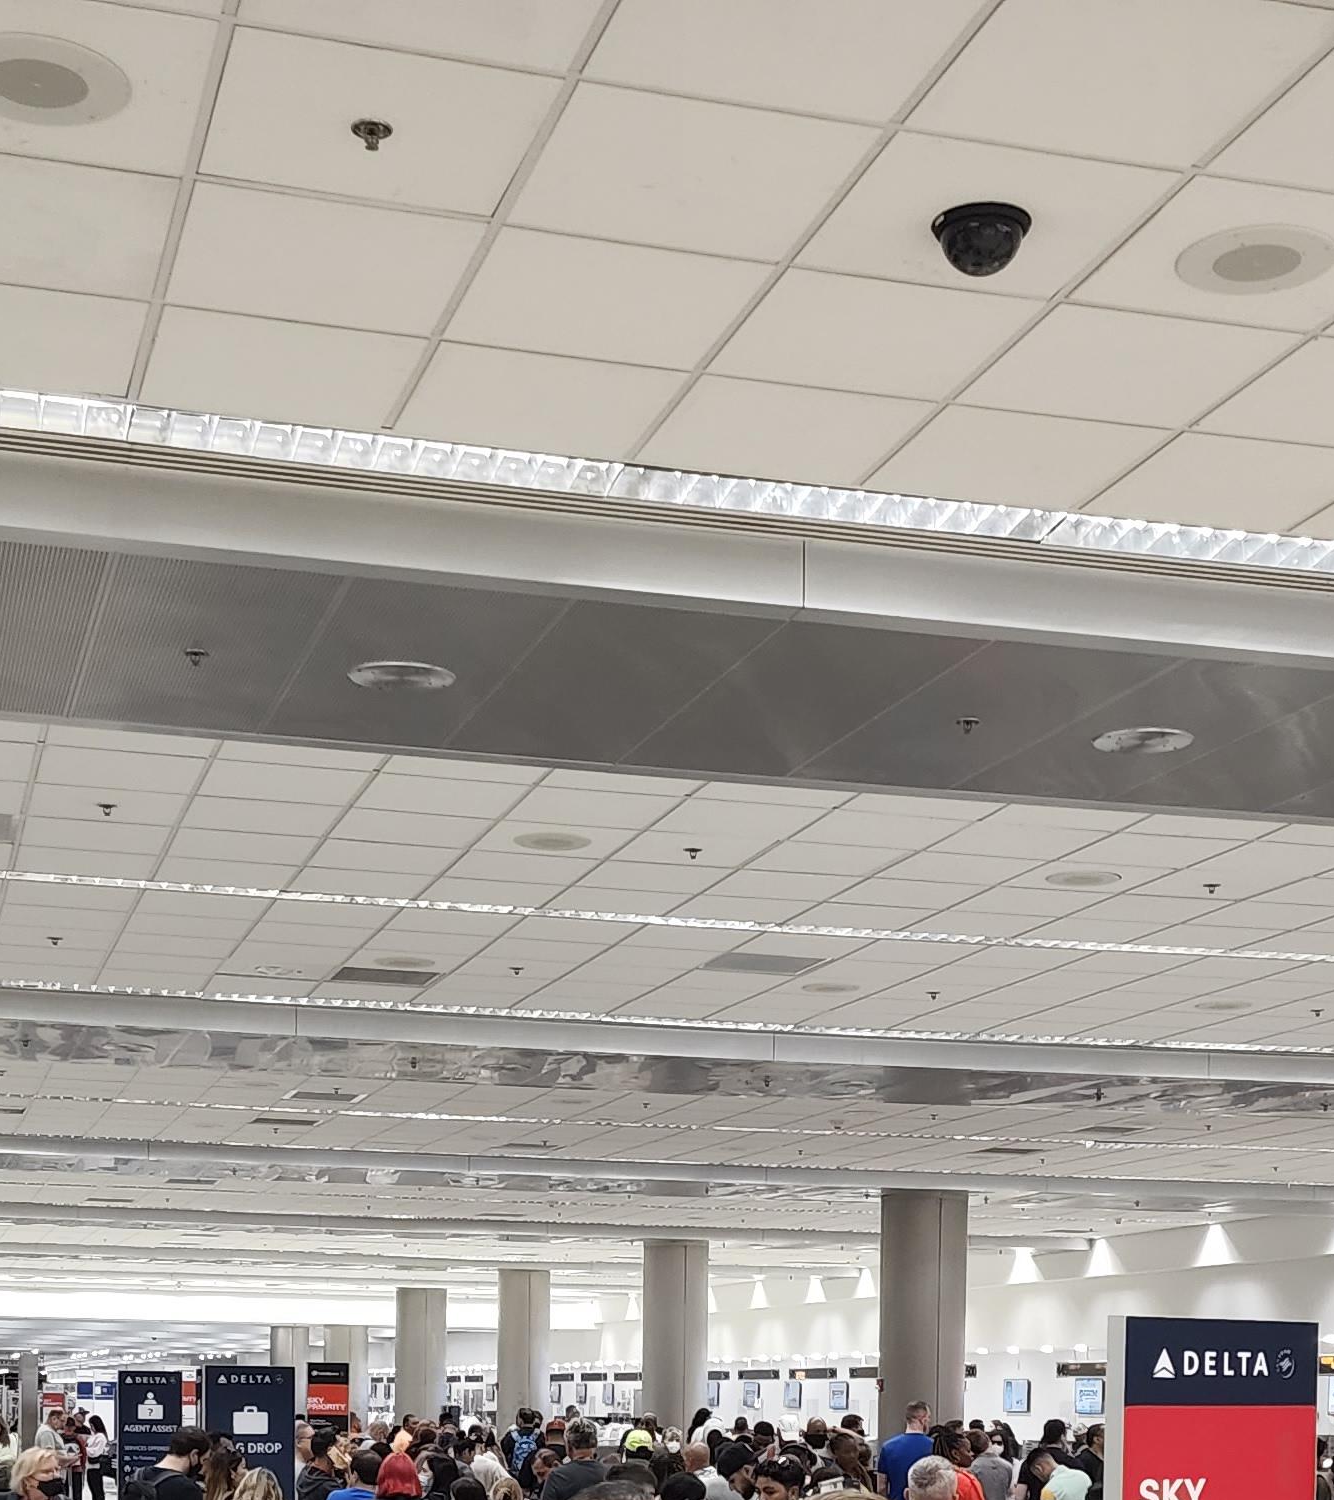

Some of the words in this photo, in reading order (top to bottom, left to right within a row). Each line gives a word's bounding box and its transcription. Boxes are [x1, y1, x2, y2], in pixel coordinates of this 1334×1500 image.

[1183, 1350, 1269, 1377] DELTA
[135, 1376, 167, 1384] DELTA
[230, 1375, 271, 1384] DELTA
[307, 1396, 324, 1404] SKY
[123, 1424, 149, 1433] AGENT
[151, 1425, 177, 1433] ASSIST
[247, 1442, 282, 1454] DROP
